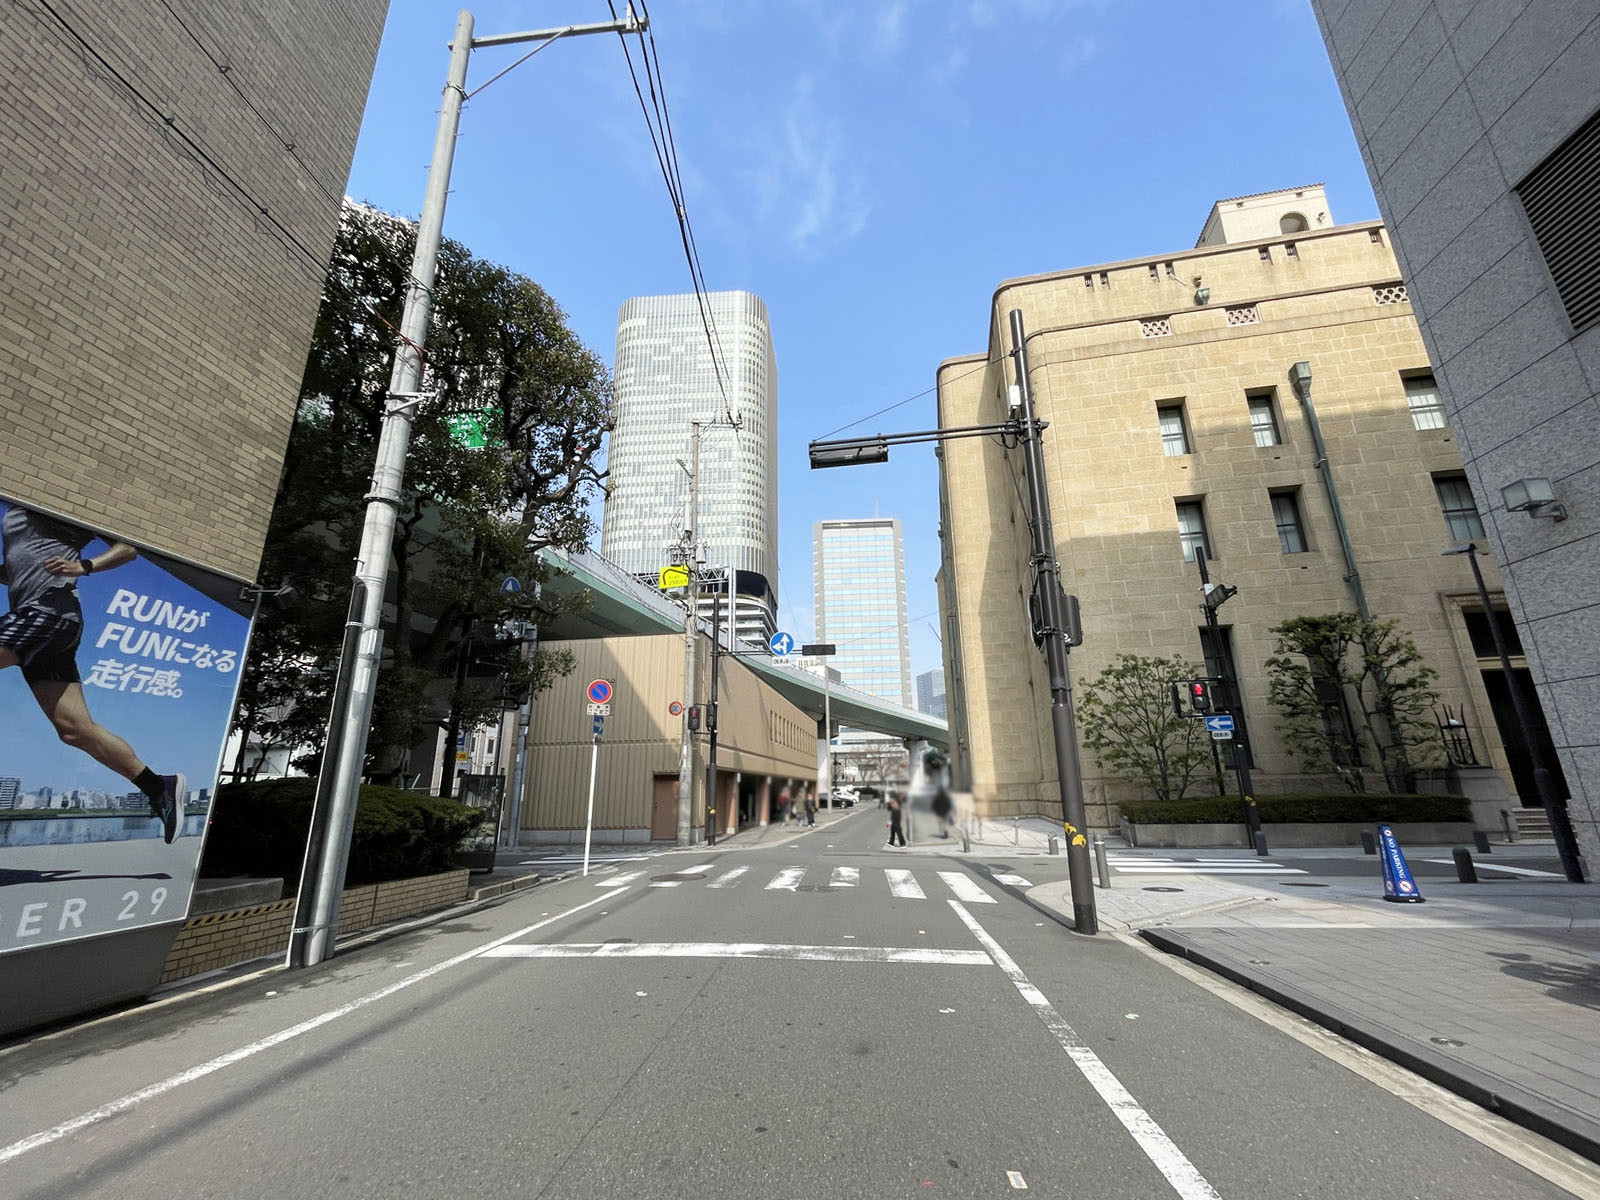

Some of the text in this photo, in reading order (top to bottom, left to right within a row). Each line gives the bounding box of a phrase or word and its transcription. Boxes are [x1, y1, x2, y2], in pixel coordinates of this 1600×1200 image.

[106, 588, 211, 633] RUNが
[95, 621, 238, 674] FUNになる
[83, 658, 184, 699] 走行感。
[1387, 838, 1406, 878] NO PARKING
[0, 886, 168, 938] ER 29
